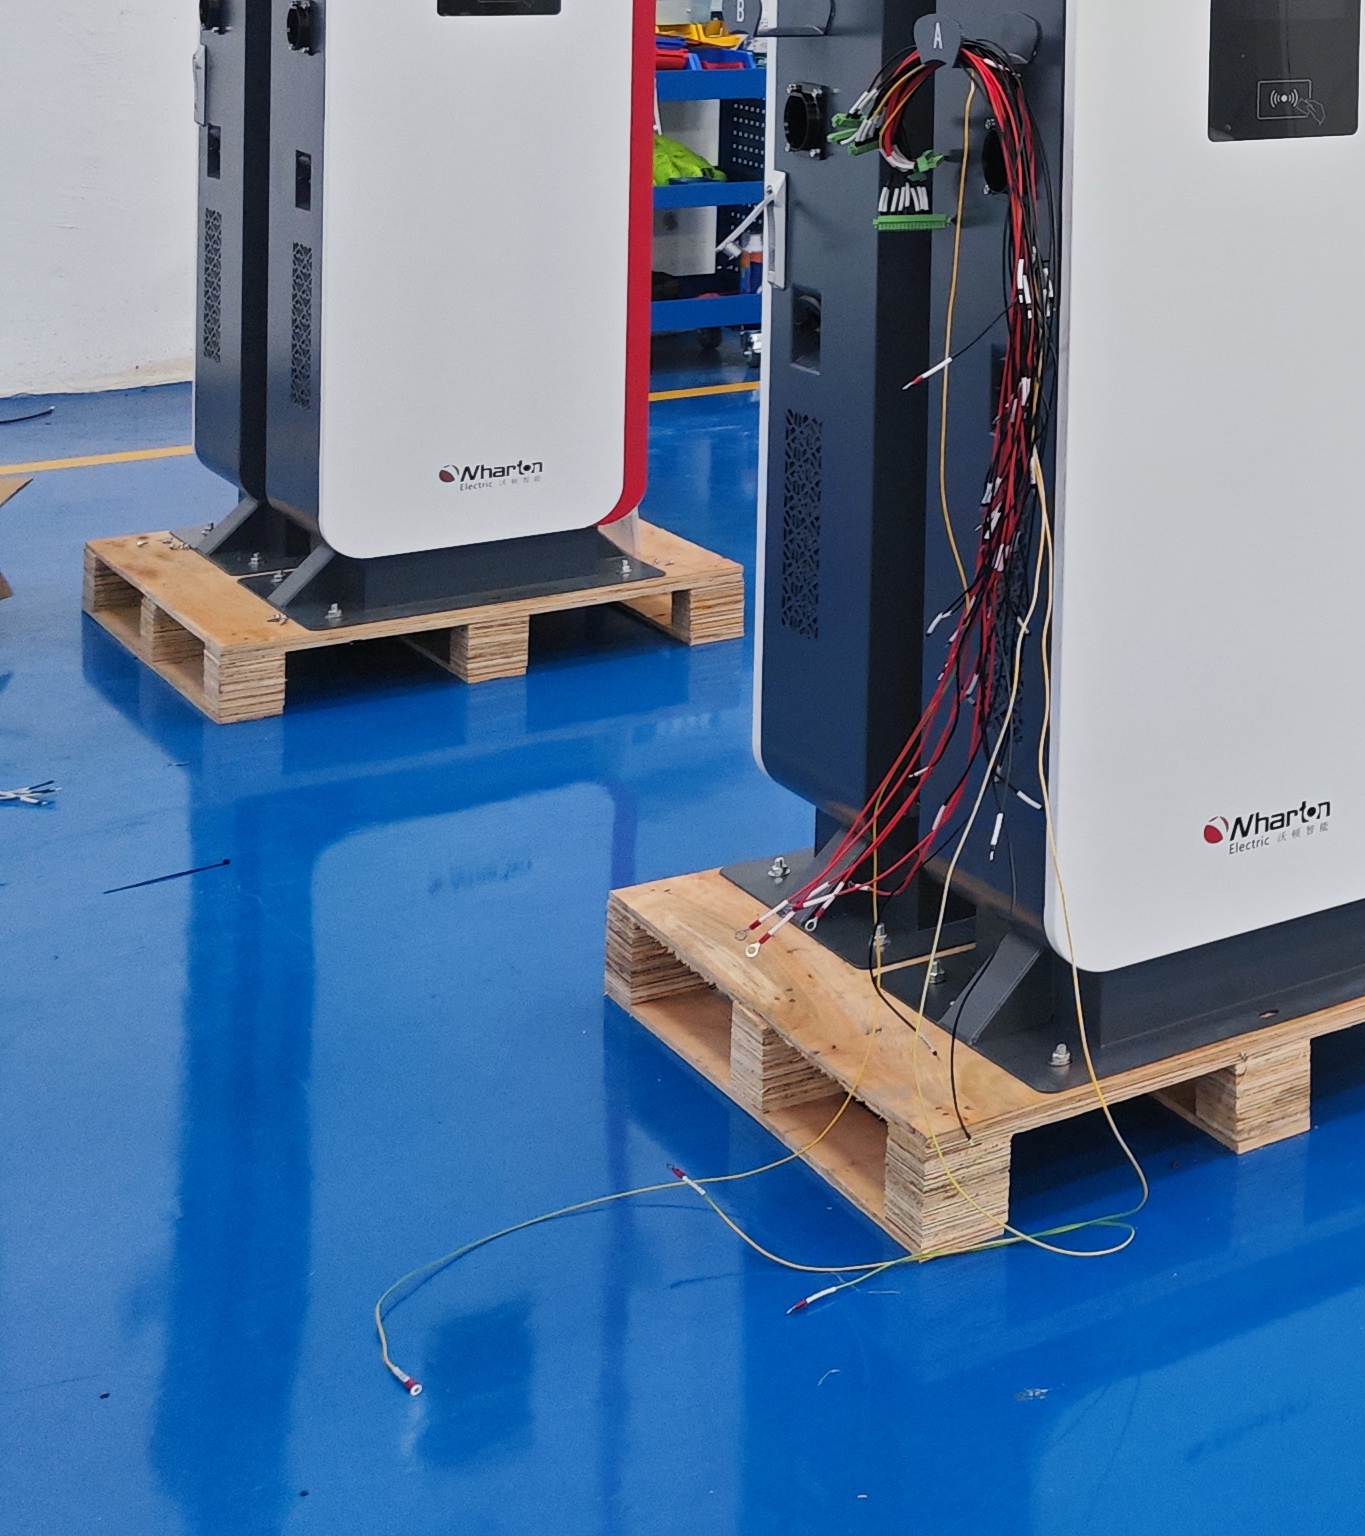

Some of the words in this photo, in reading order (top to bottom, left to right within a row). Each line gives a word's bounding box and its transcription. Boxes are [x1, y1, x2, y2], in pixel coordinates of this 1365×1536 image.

[932, 20, 944, 50] A
[459, 459, 543, 483] Wharton
[459, 480, 493, 491] Electric
[1229, 800, 1331, 842] Wharton
[1228, 835, 1270, 855] Electric
